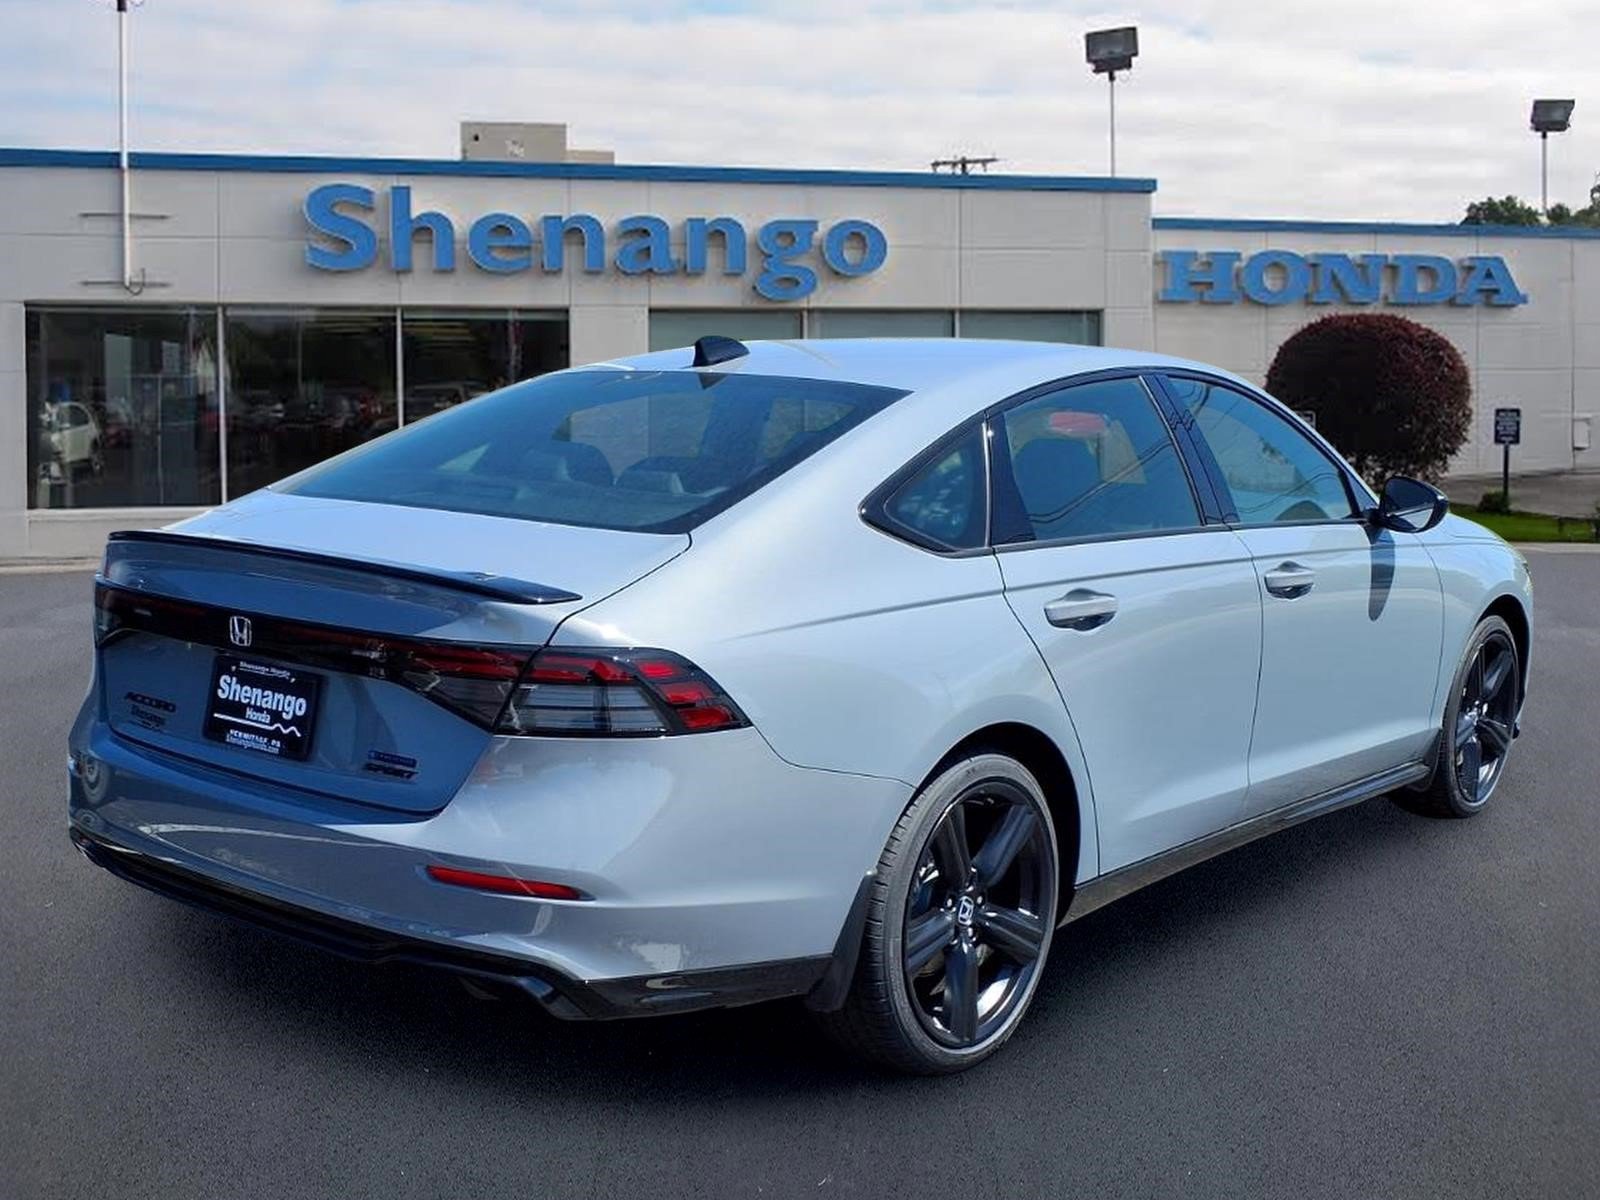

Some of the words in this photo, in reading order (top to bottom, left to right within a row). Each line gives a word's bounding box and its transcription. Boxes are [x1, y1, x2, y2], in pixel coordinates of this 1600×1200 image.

[303, 183, 888, 302] Shenango
[1157, 250, 1528, 306] HONDA
[217, 674, 307, 720] Shenango
[245, 707, 271, 723] Honda
